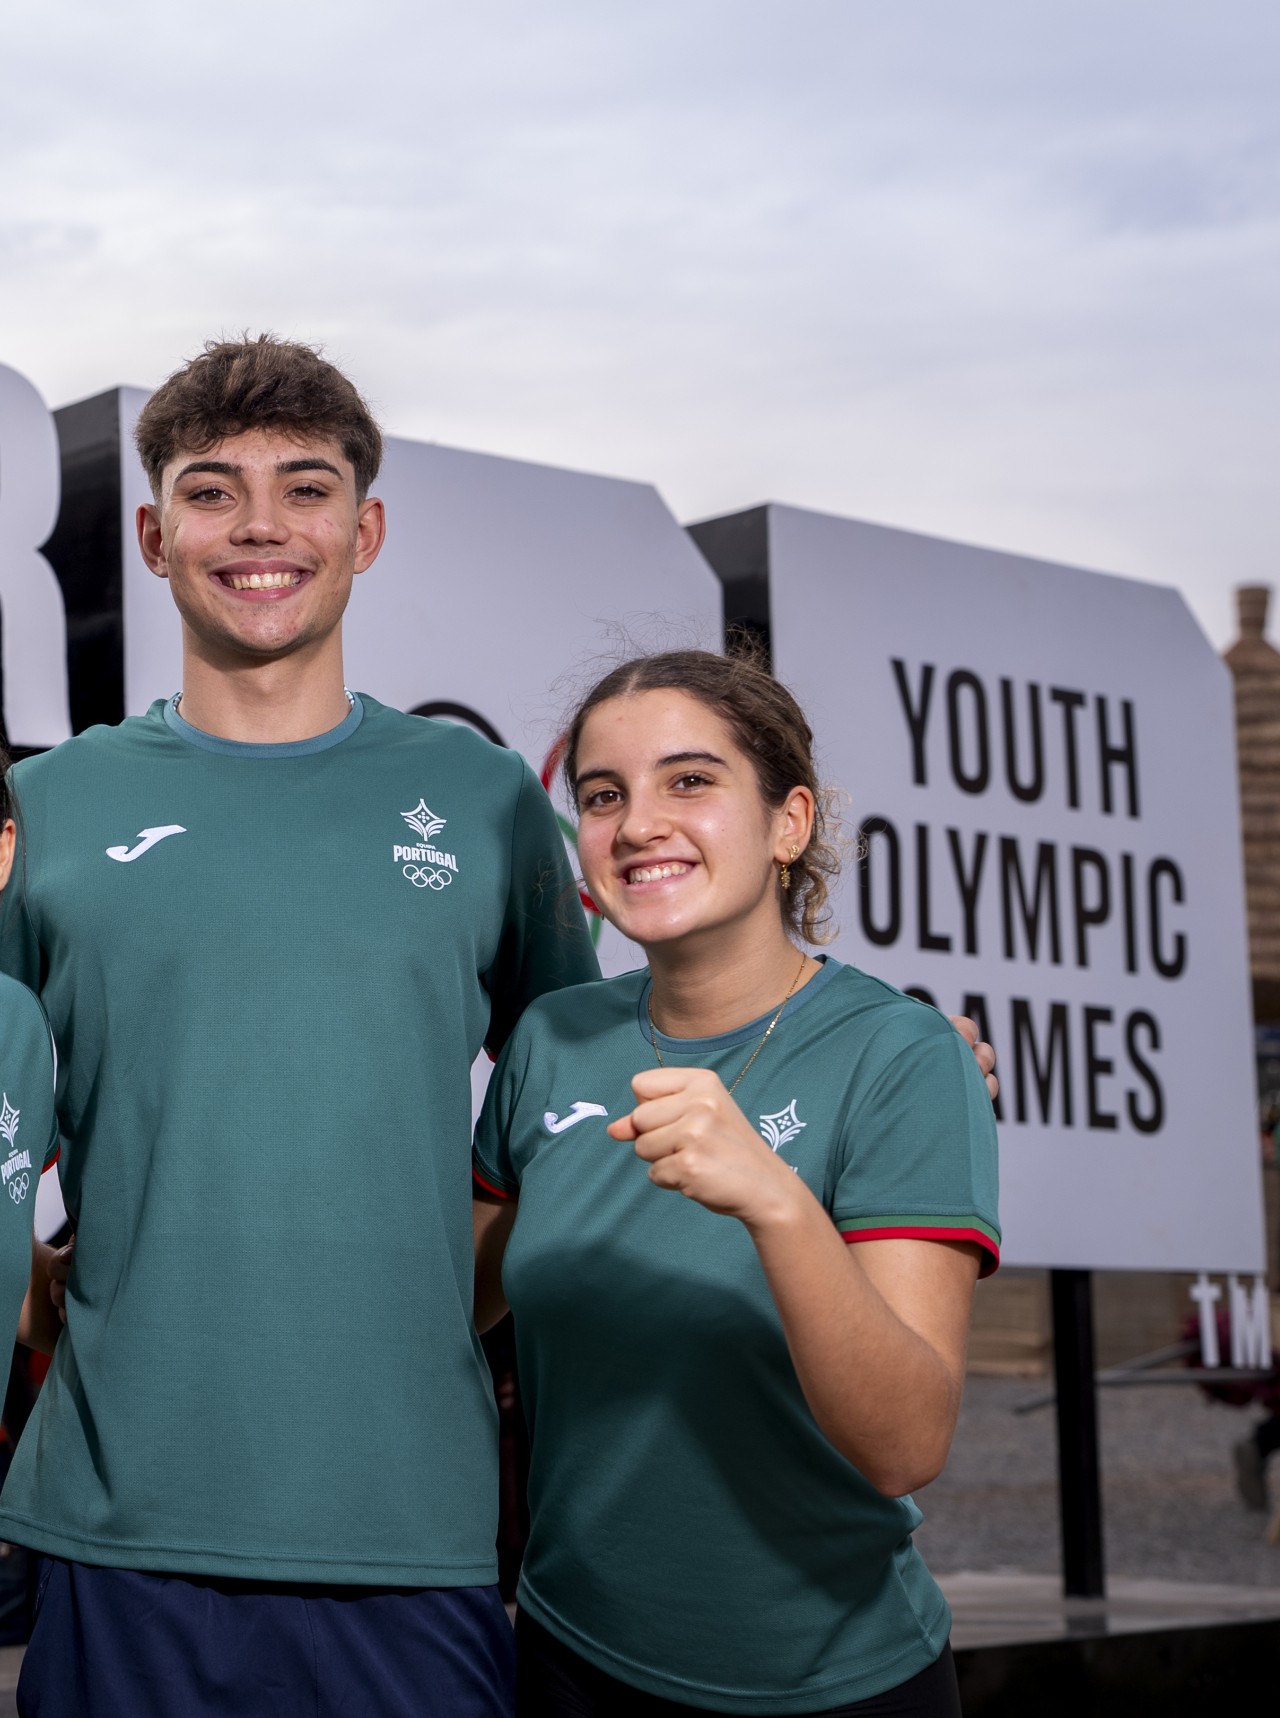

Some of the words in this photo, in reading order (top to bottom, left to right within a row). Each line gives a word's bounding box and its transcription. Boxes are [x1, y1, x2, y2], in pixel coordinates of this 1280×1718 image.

[889, 656, 1141, 820] YOUTH
[393, 845, 459, 872] PORTUGAL
[856, 814, 1189, 982] OLYMPIC
[900, 985, 1167, 1137] AMES
[1, 1149, 32, 1185] PORTUGAL
[1189, 1281, 1272, 1370] TM
